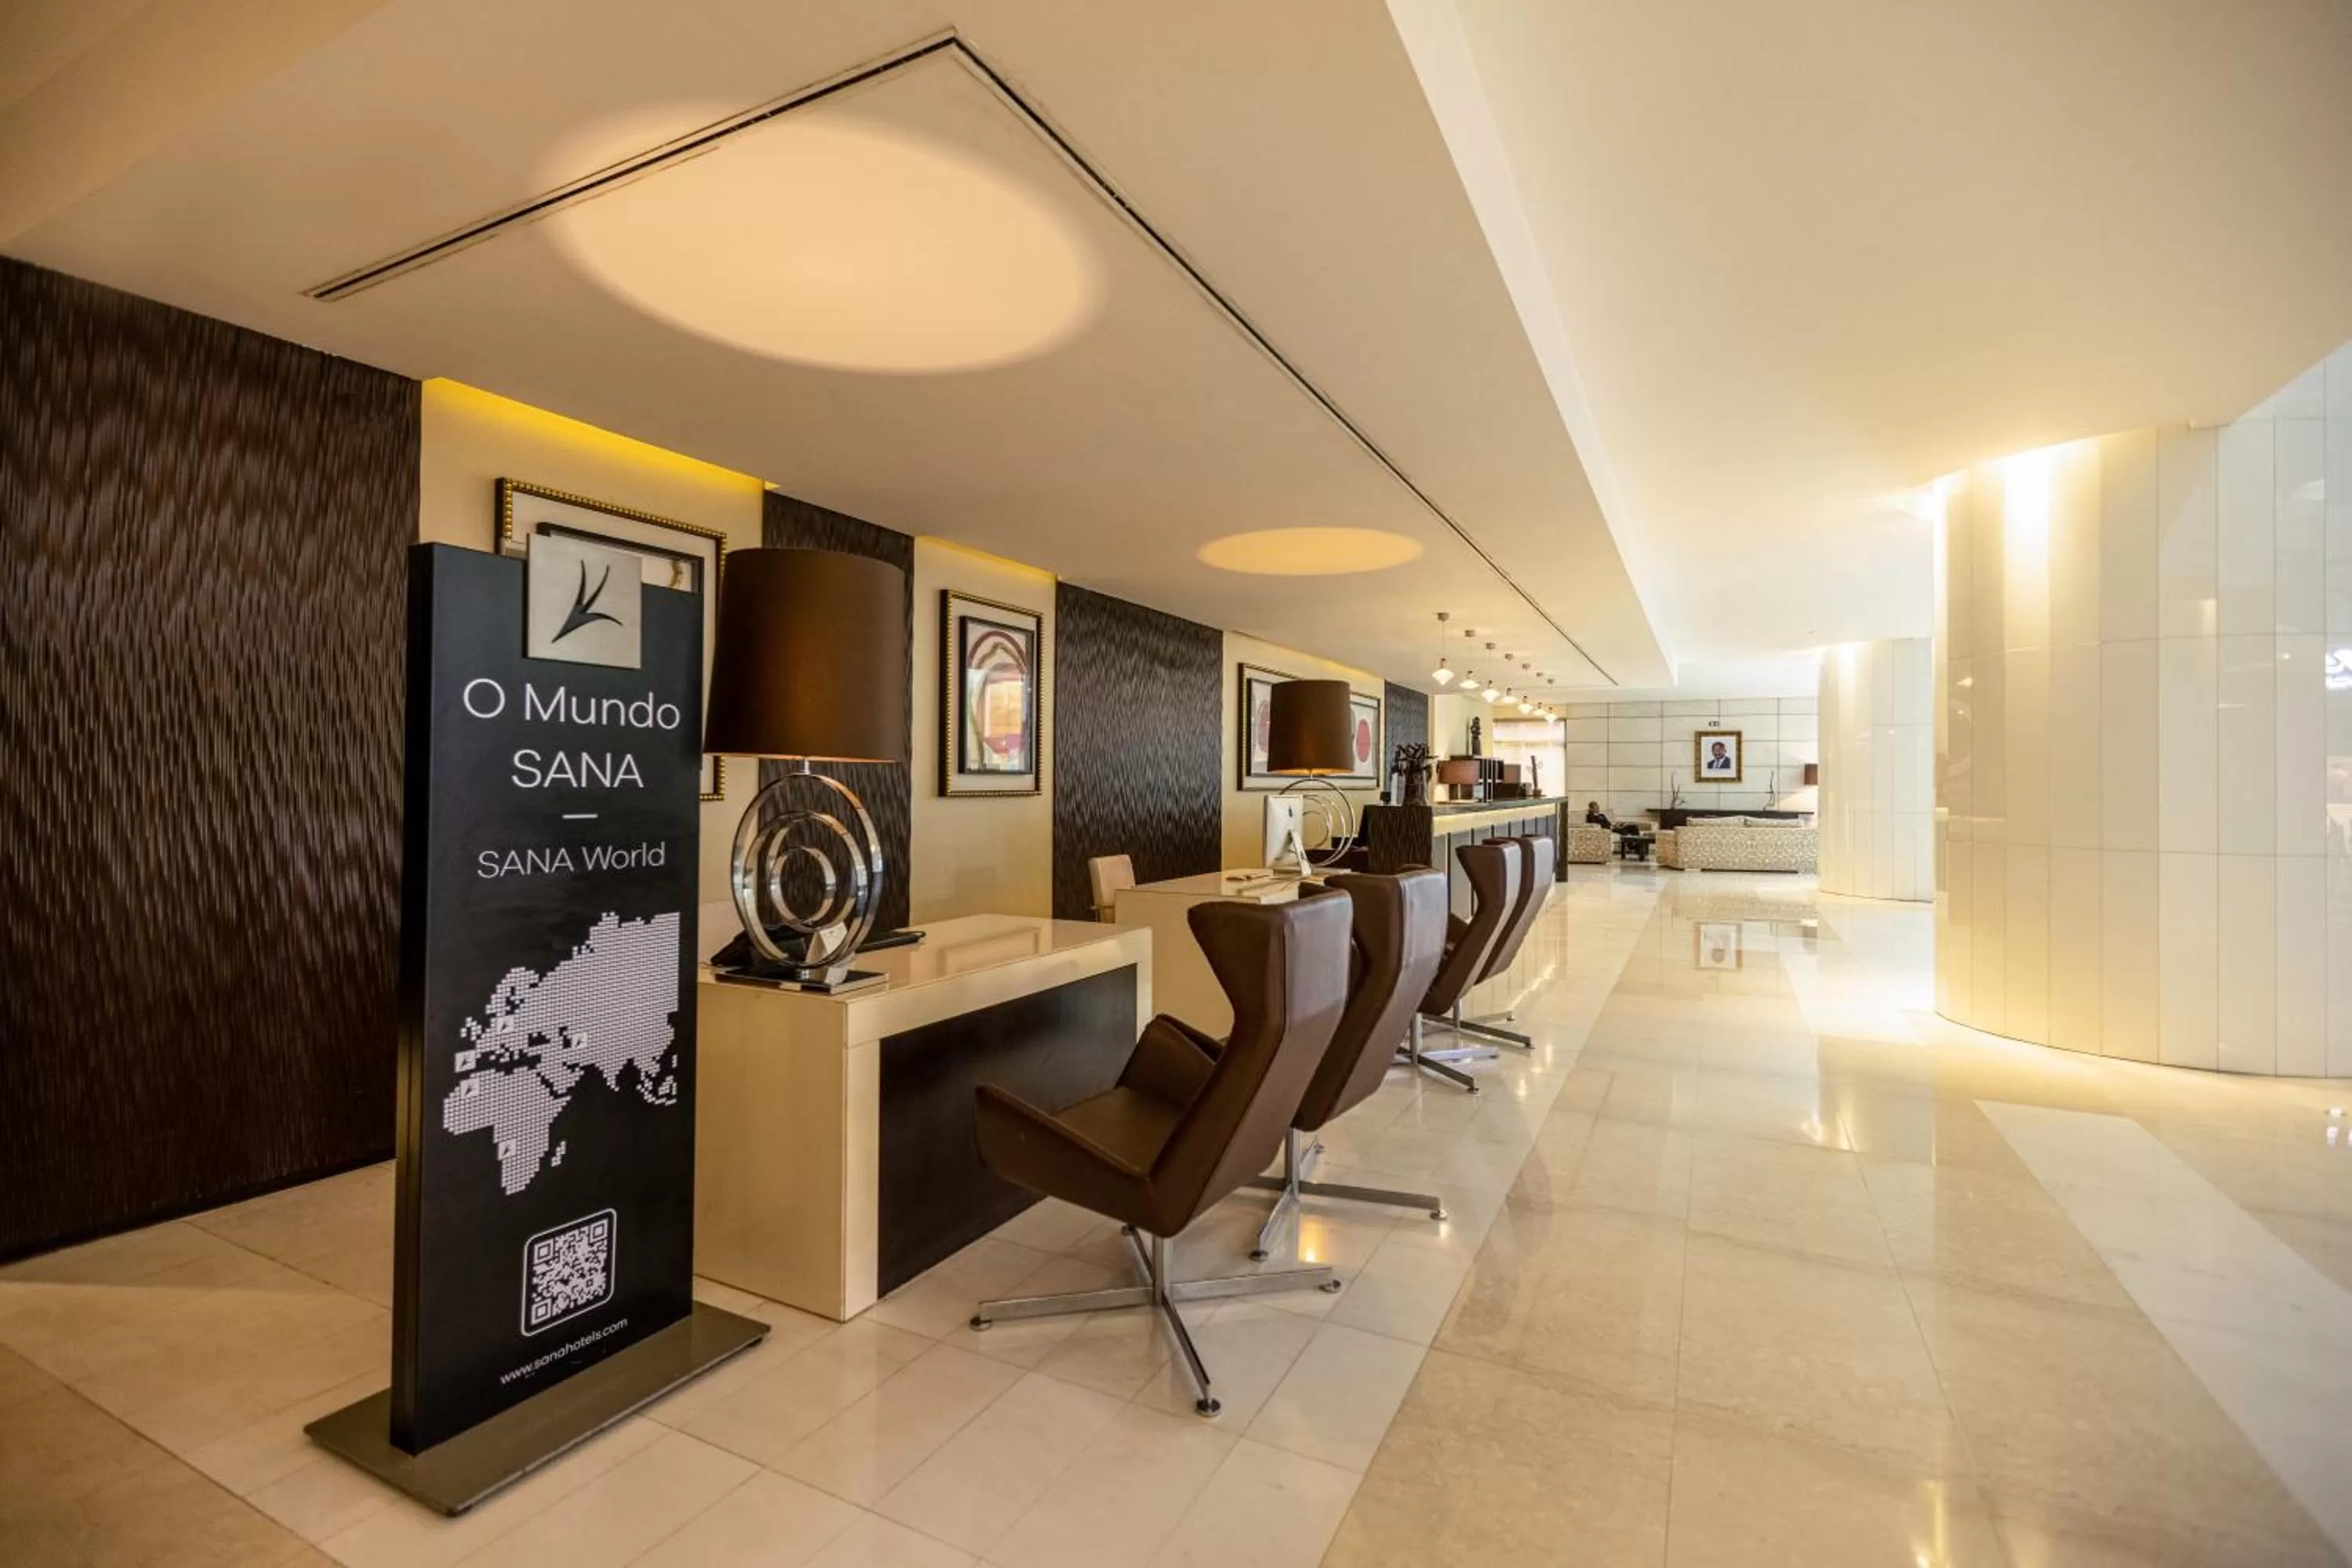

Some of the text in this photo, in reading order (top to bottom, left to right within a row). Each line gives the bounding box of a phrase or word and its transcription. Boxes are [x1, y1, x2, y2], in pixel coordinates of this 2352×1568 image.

[463, 677, 681, 730] O Mundo
[511, 749, 644, 789] SANA
[477, 841, 666, 879] SANA World
[499, 1318, 628, 1385] www.sanahotels.com
